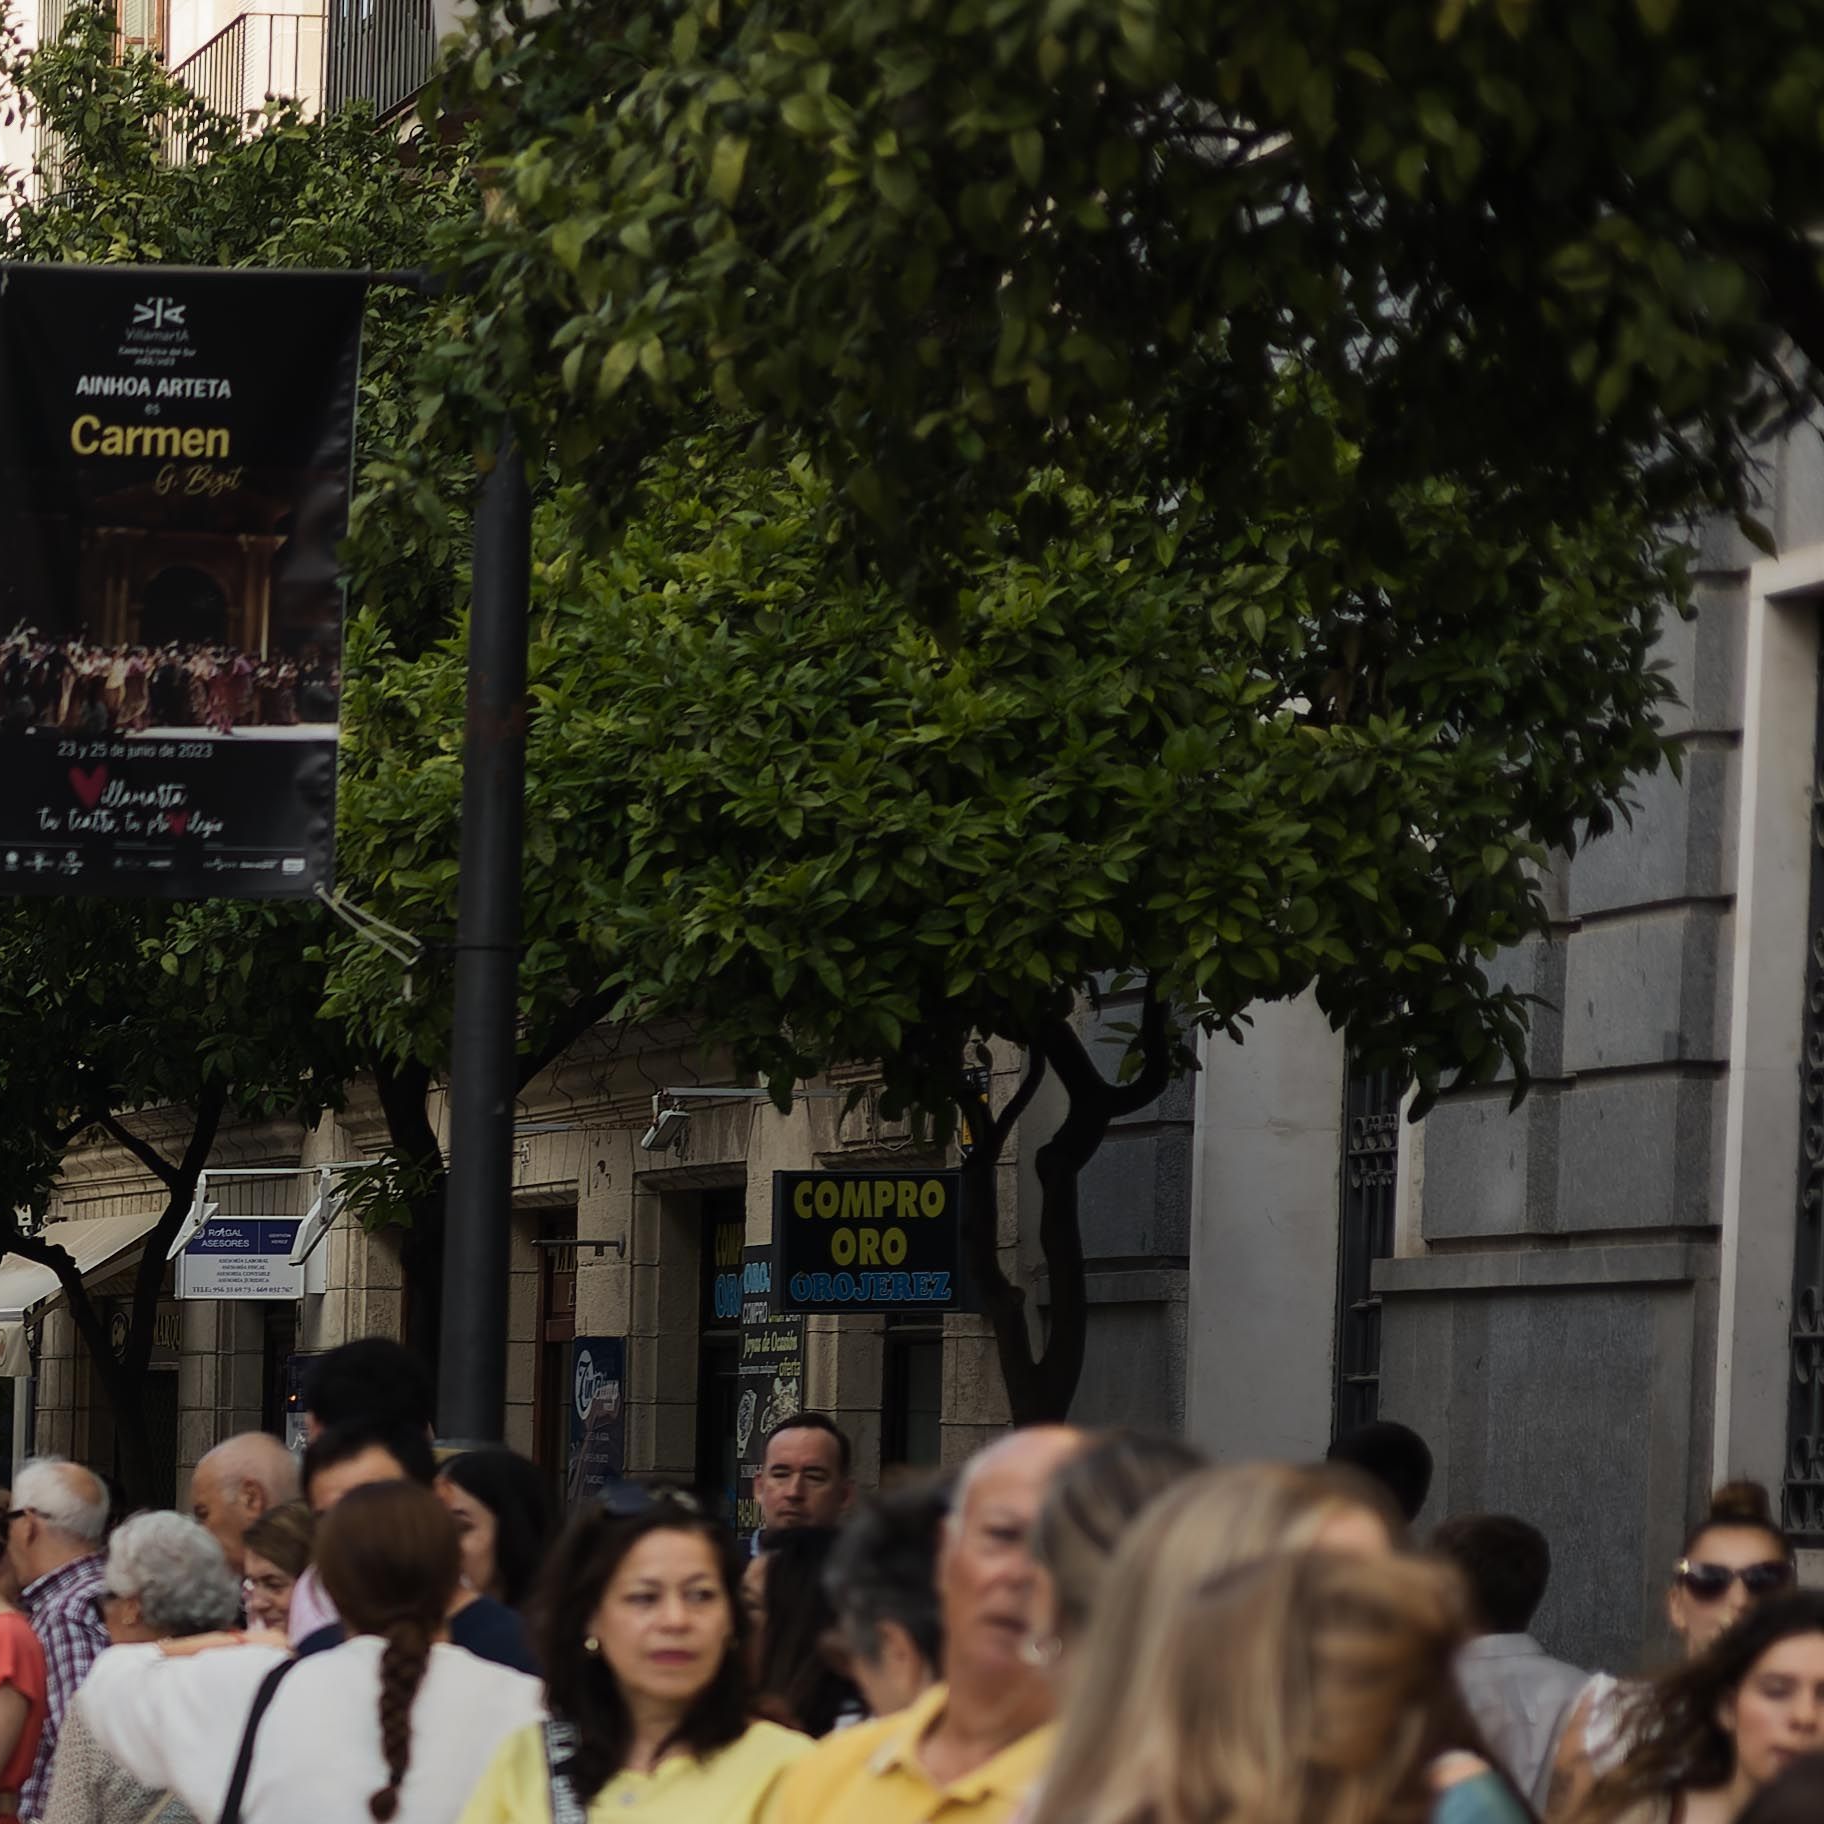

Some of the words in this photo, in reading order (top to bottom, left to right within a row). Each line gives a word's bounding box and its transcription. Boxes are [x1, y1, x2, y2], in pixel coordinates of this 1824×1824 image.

[75, 375, 151, 397] AINHOA
[156, 377, 232, 399] ARTETA
[144, 402, 161, 416] es
[70, 413, 231, 458] Carmen
[57, 741, 75, 757] 23
[78, 745, 87, 760] y
[90, 741, 107, 757] 25
[110, 742, 126, 758] de
[158, 742, 175, 758] de
[178, 742, 214, 759] 2023
[793, 1179, 946, 1219] COMPRO
[201, 1239, 250, 1247] ASESORES
[831, 1226, 908, 1266] ORO
[789, 1272, 953, 1302] OROJEREZ
